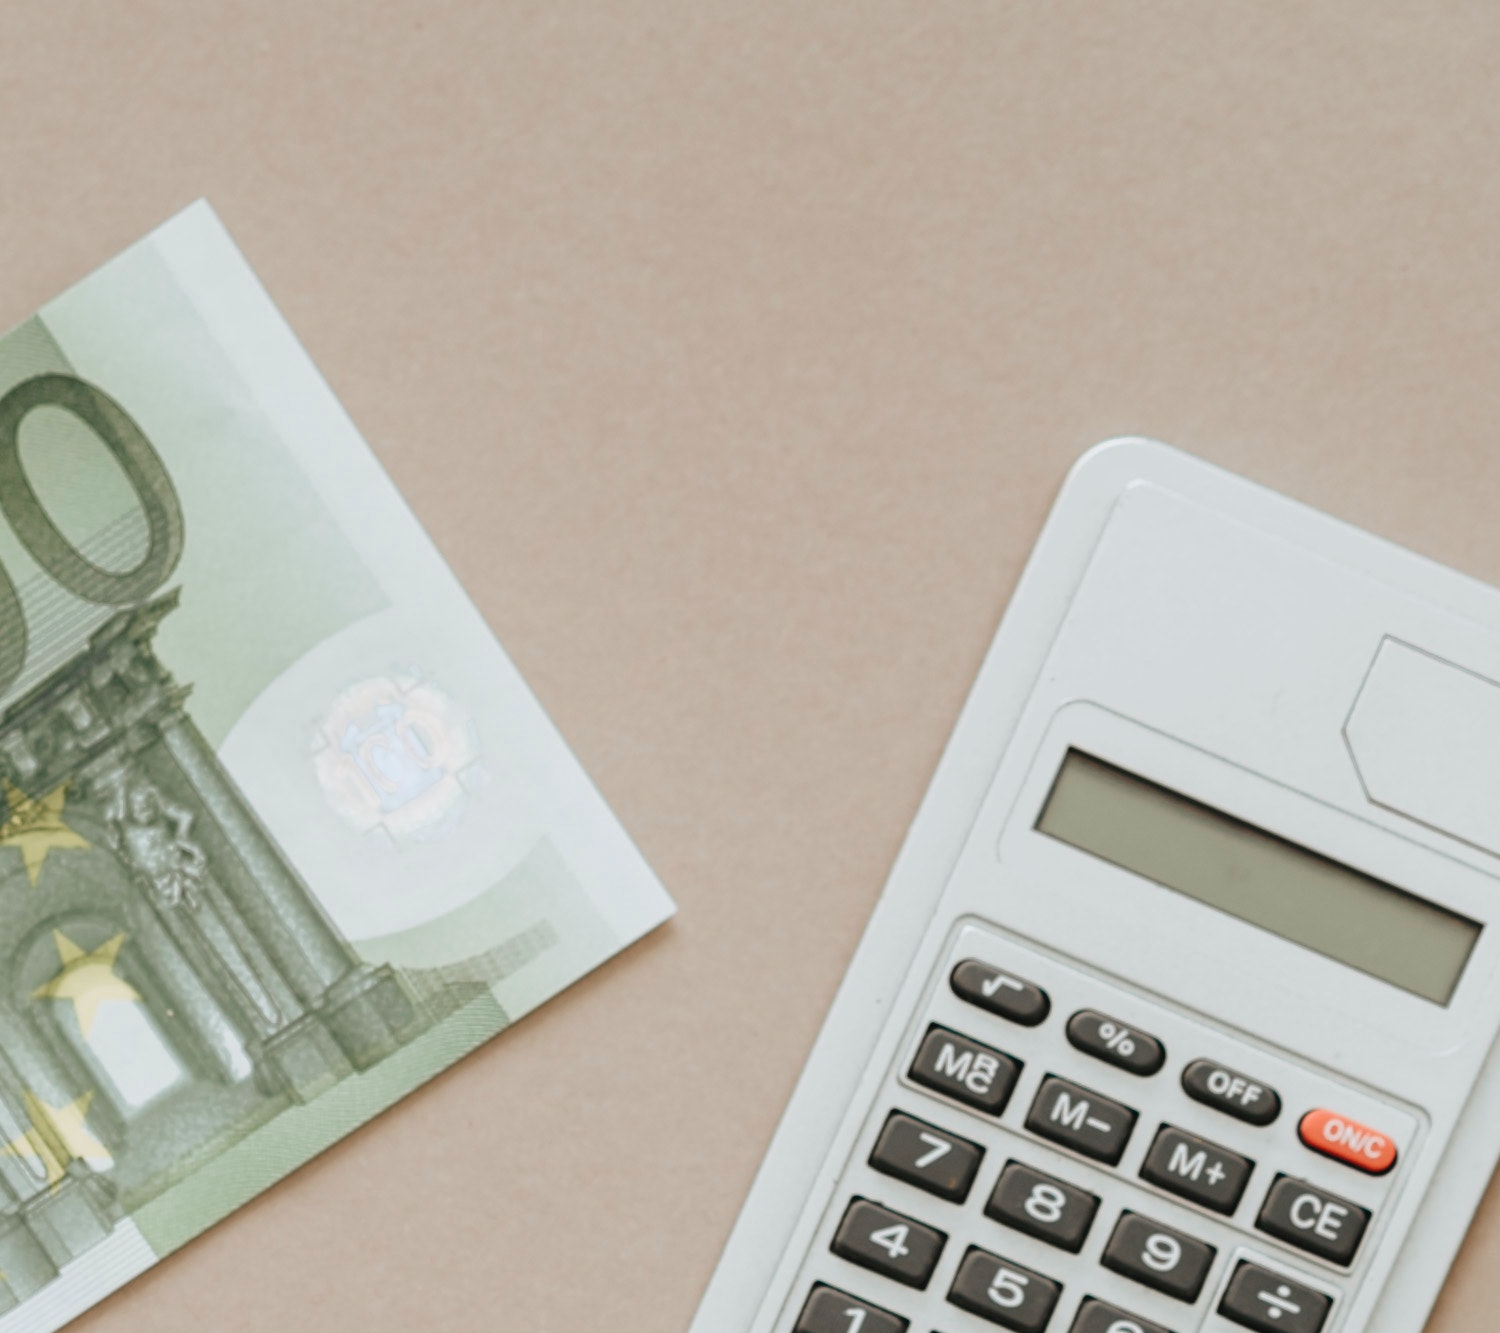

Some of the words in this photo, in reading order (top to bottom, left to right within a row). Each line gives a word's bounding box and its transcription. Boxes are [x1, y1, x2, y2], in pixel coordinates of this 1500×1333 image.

[1098, 1020, 1136, 1057] %
[1206, 1069, 1263, 1106] OFF
[1323, 1118, 1385, 1159] ON/C
[915, 1132, 952, 1168] 7
[1024, 1183, 1066, 1223] 8
[1141, 1233, 1182, 1272] 9
[1168, 1142, 1226, 1185] M+
[1289, 1193, 1349, 1240] CE
[870, 1224, 909, 1258] 4
[986, 1271, 1029, 1311] 5
